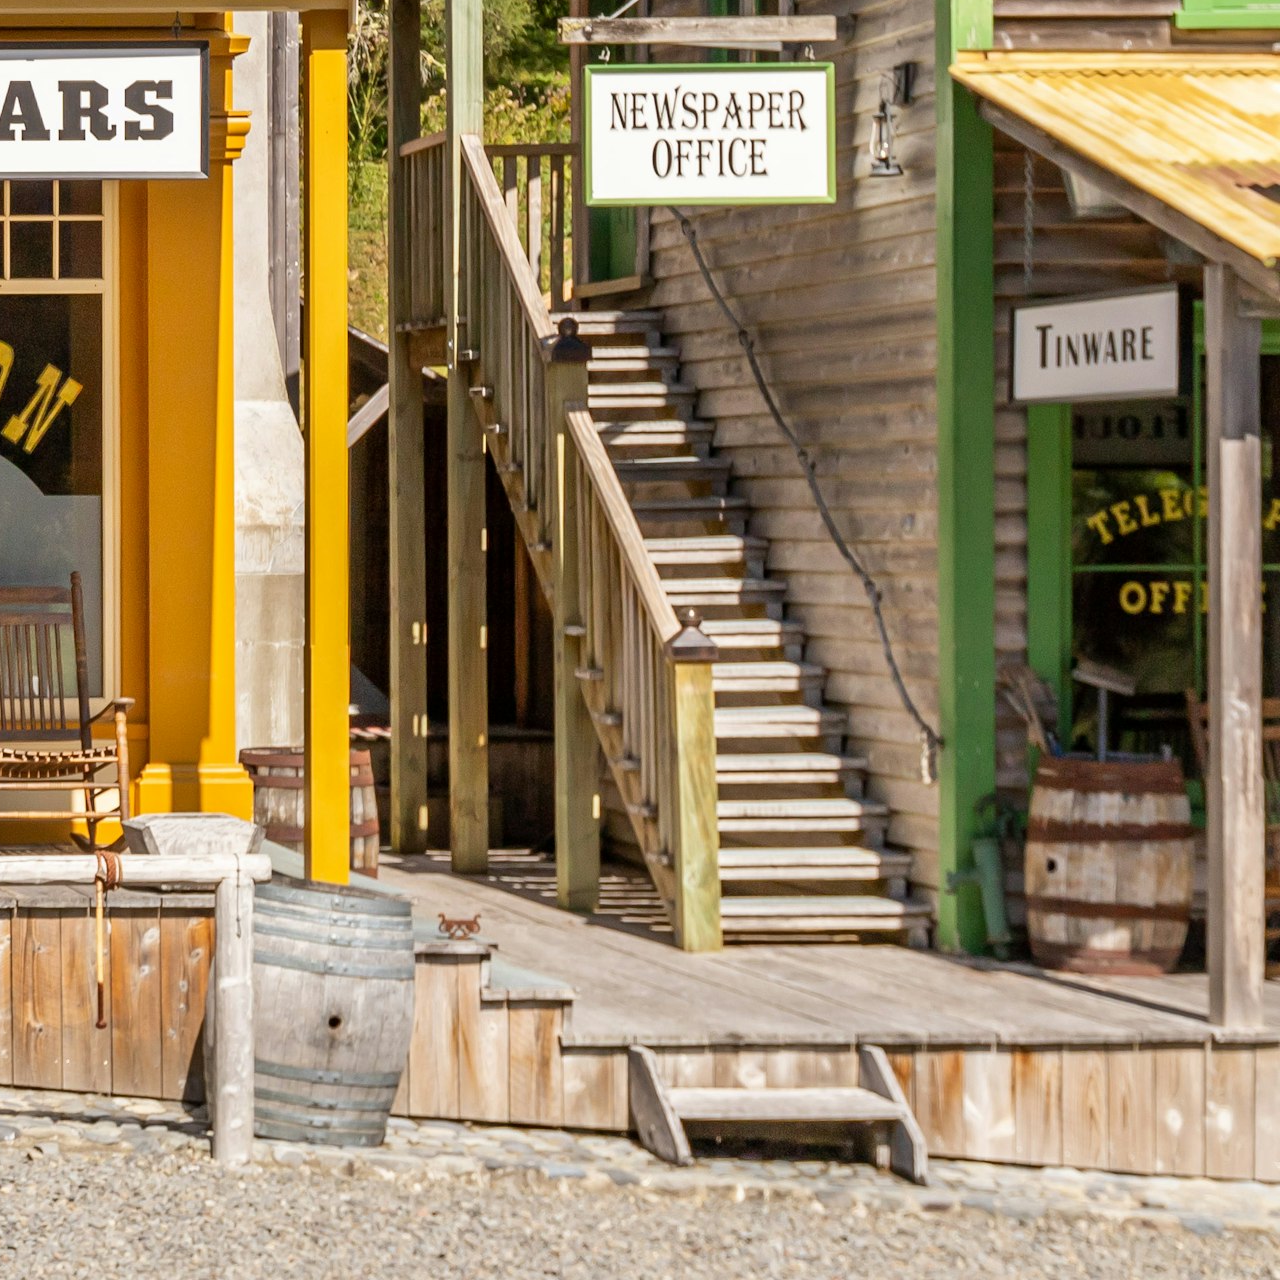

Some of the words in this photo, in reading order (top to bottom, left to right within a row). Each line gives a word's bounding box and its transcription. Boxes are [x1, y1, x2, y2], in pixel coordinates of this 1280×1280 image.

[610, 85, 808, 132] NEWSPAPER
[652, 138, 768, 178] OFFICE
[1036, 324, 1154, 369] TINWARE
[1087, 486, 1280, 545] TELEG
